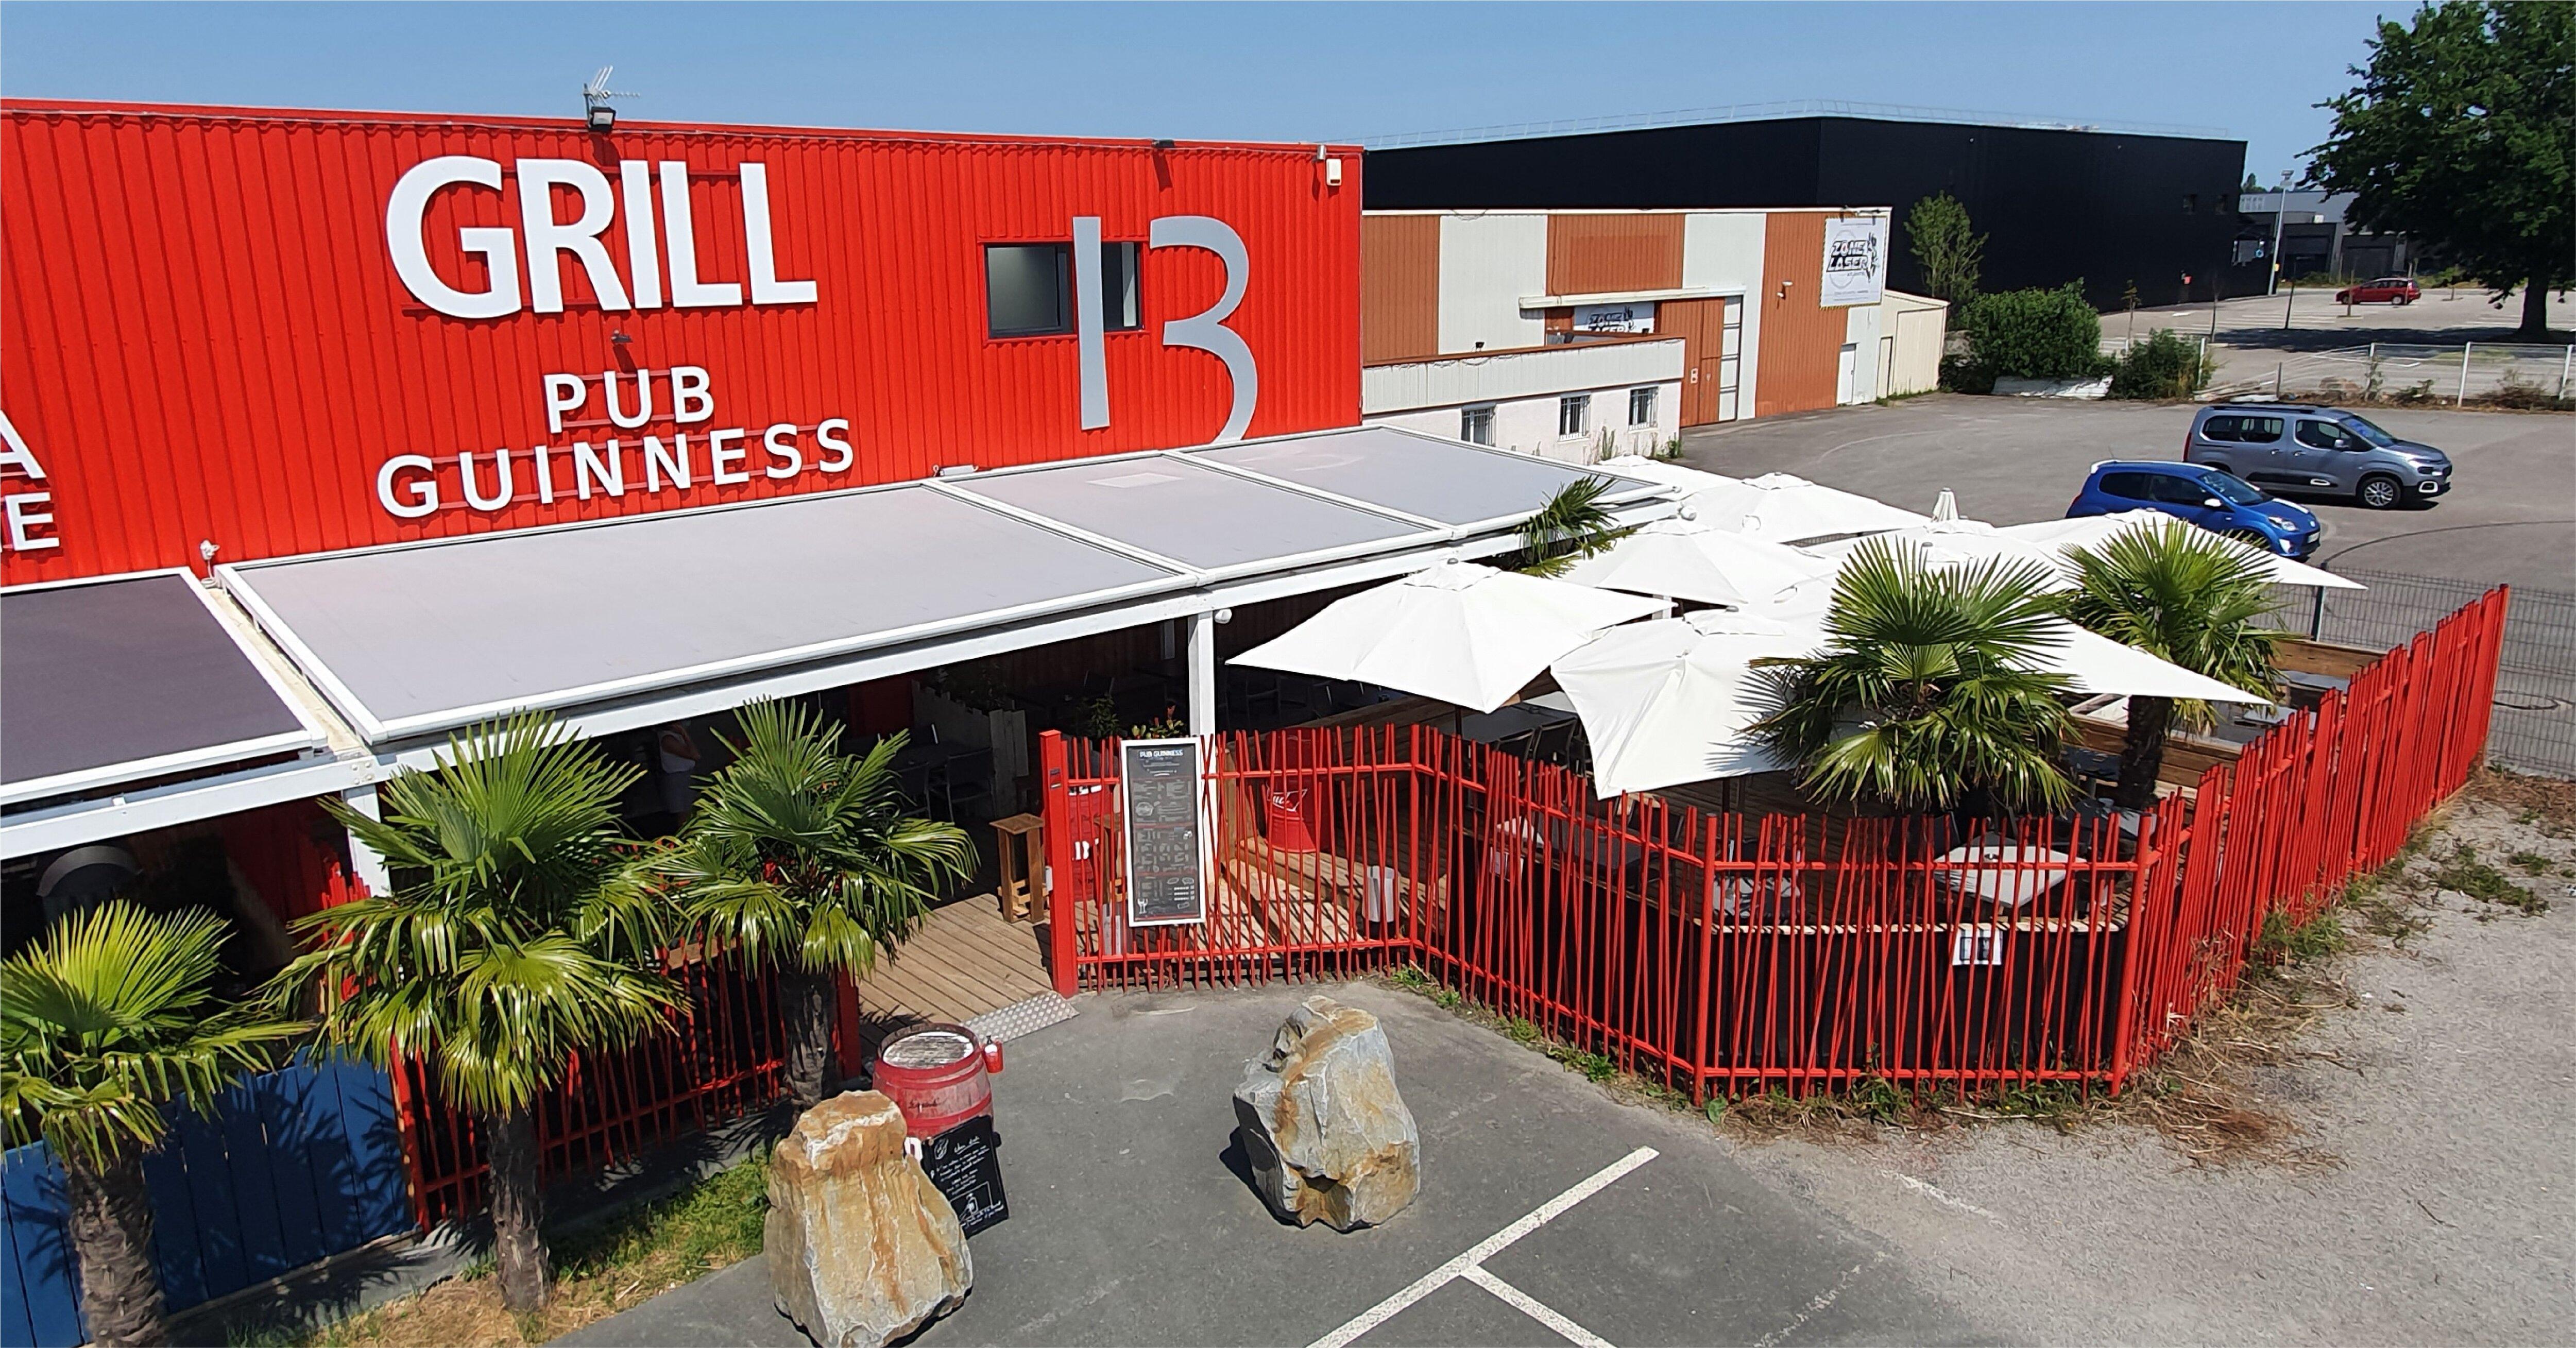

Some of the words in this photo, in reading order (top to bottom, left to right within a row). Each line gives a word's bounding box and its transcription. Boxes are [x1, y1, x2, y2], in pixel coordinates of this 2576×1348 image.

[386, 155, 818, 318] GRILL
[1827, 256, 1869, 271] LASER
[1072, 215, 1258, 443] 13
[543, 365, 714, 433] PUB
[377, 418, 854, 518] GUINNESS
